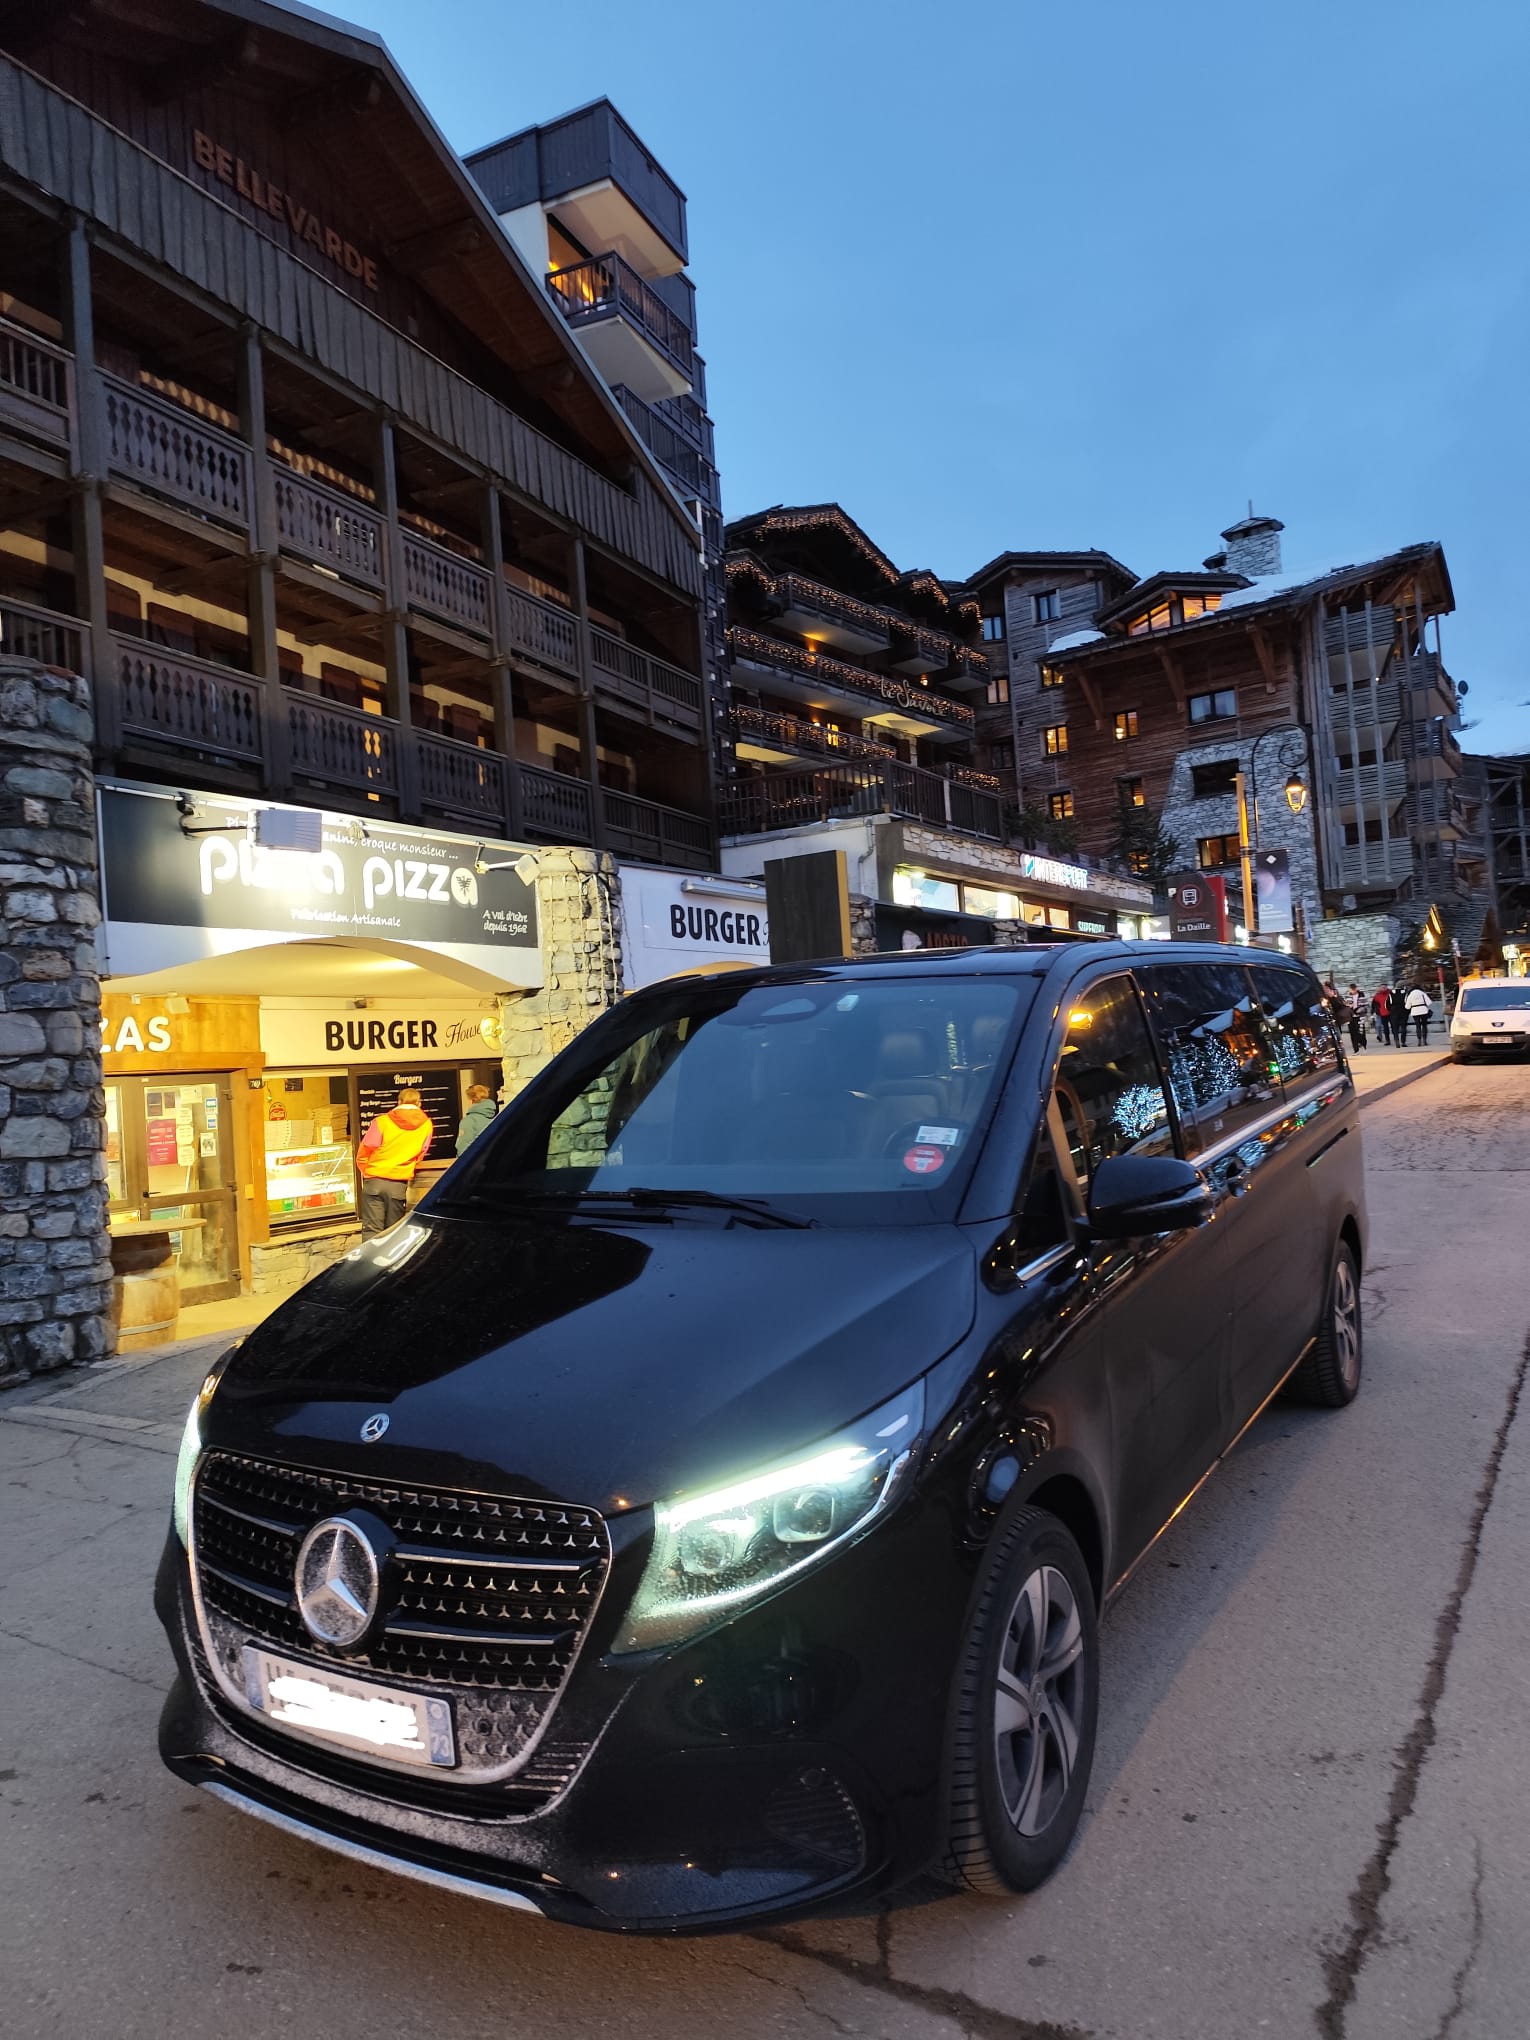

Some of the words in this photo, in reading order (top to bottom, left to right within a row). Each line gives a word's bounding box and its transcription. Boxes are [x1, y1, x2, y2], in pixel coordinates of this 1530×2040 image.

[193, 128, 378, 292] BELLEVARDE
[361, 837, 397, 853] croque
[399, 843, 447, 858] monsieur
[200, 835, 345, 896] pia
[363, 855, 479, 910] pizza
[1033, 856, 1088, 890] INTERSPORT
[350, 913, 401, 928] Artisanale
[482, 909, 491, 920] A
[670, 904, 761, 946] BURGER
[483, 920, 508, 935] depuis
[1177, 924, 1187, 933] La
[325, 1019, 439, 1051] BURGER
[444, 1018, 481, 1048] House
[393, 1074, 423, 1086] Burgers
